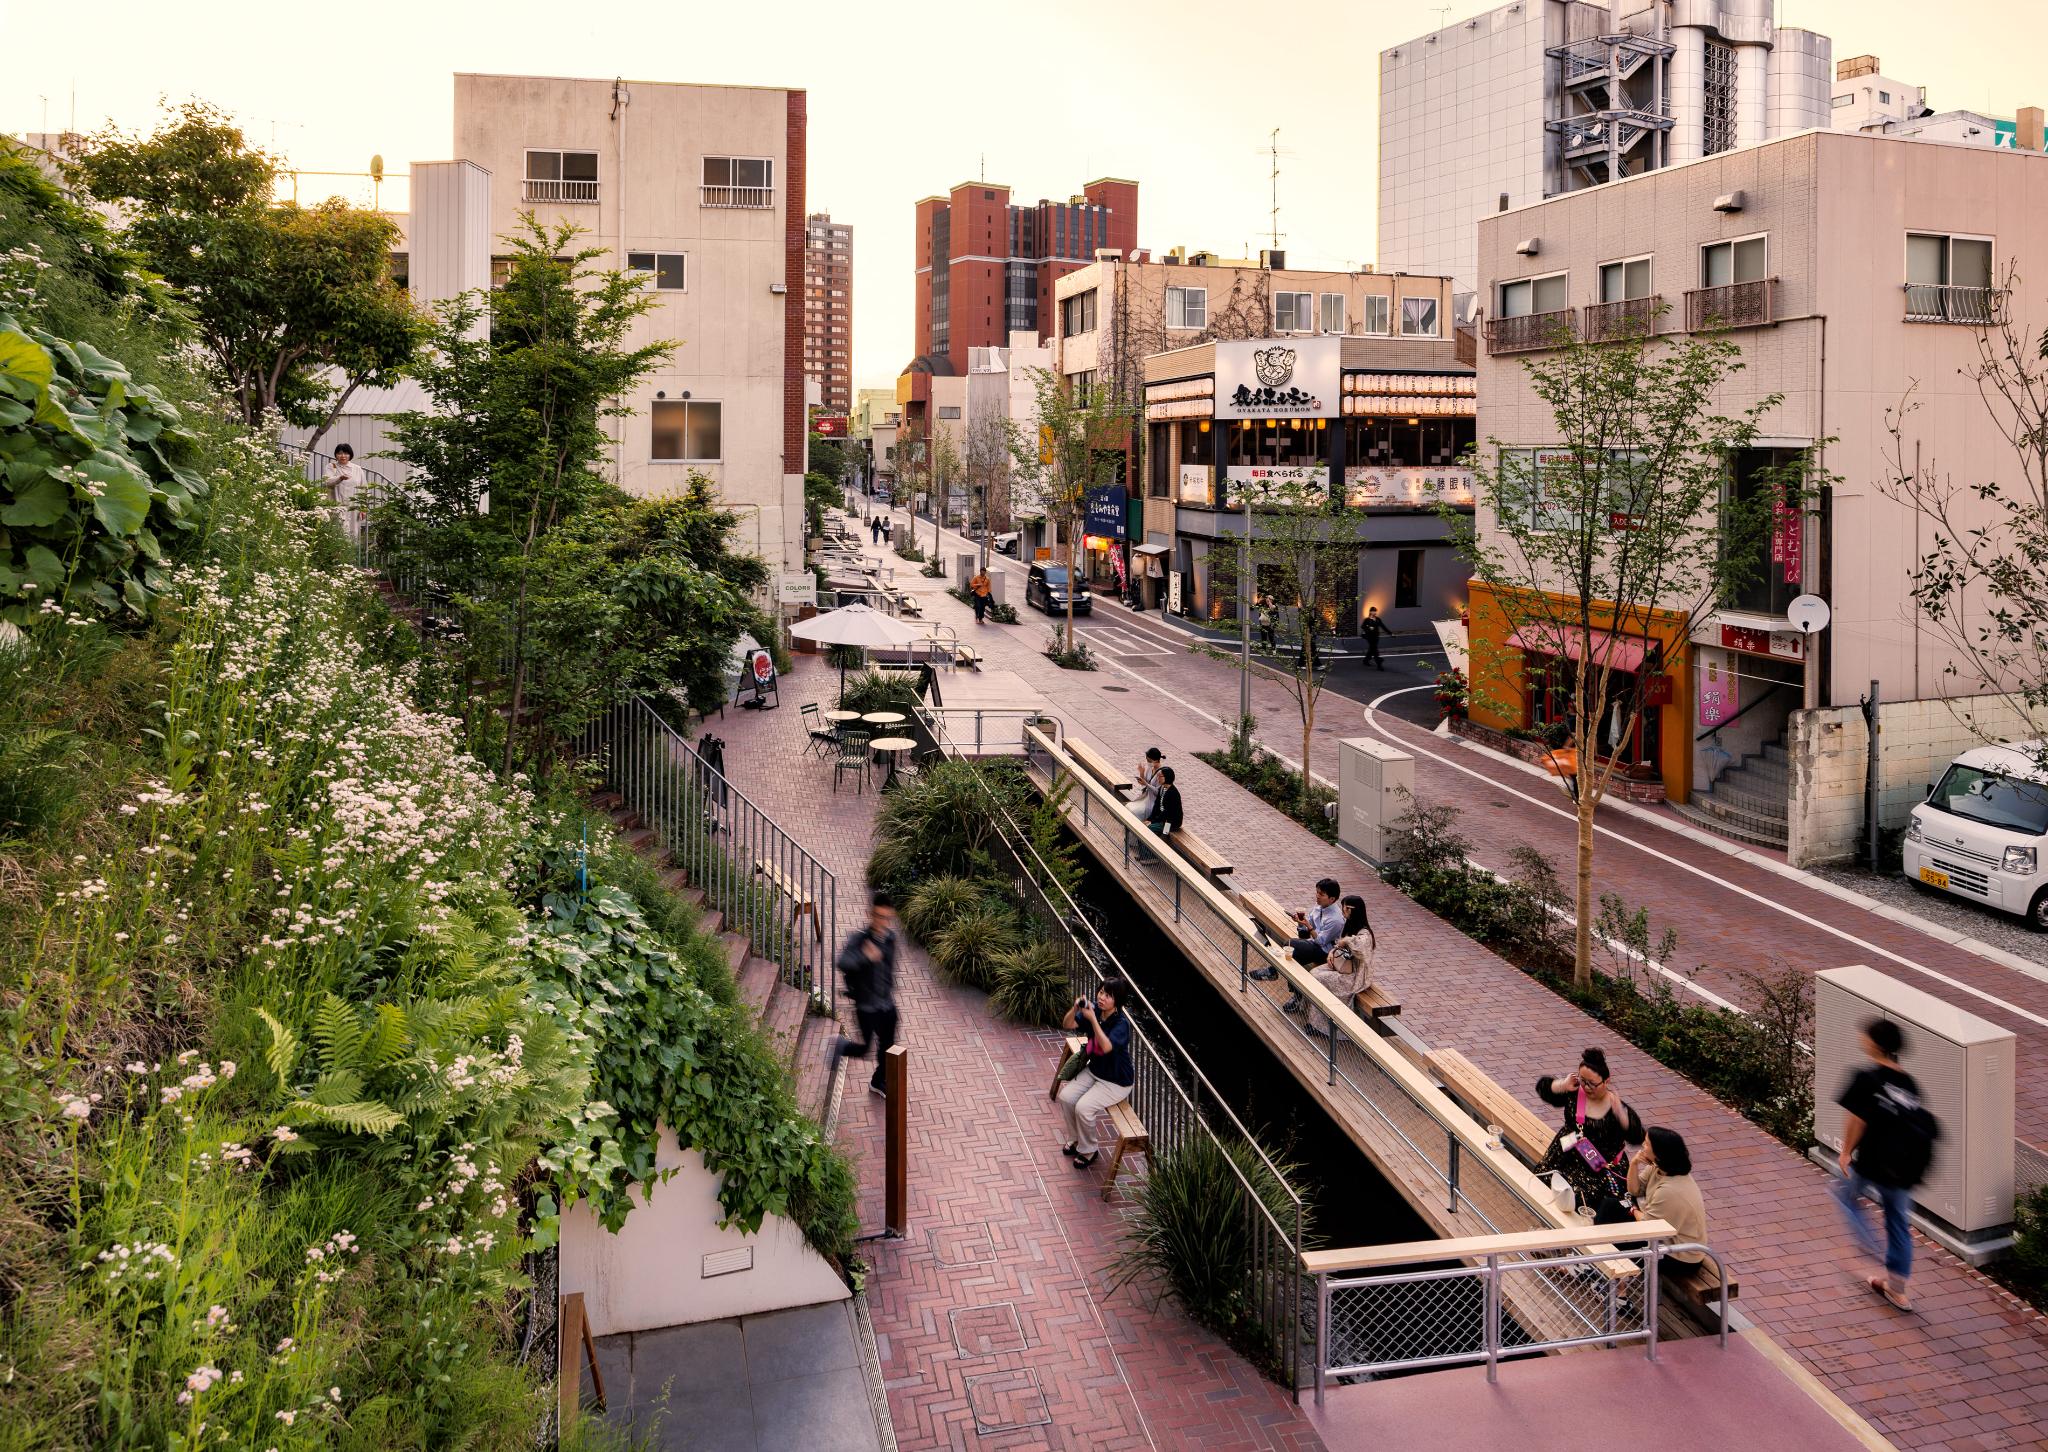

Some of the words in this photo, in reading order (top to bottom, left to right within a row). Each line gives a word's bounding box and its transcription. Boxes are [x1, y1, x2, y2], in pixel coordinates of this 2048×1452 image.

[1251, 469, 1304, 478] 毎日食べられる
